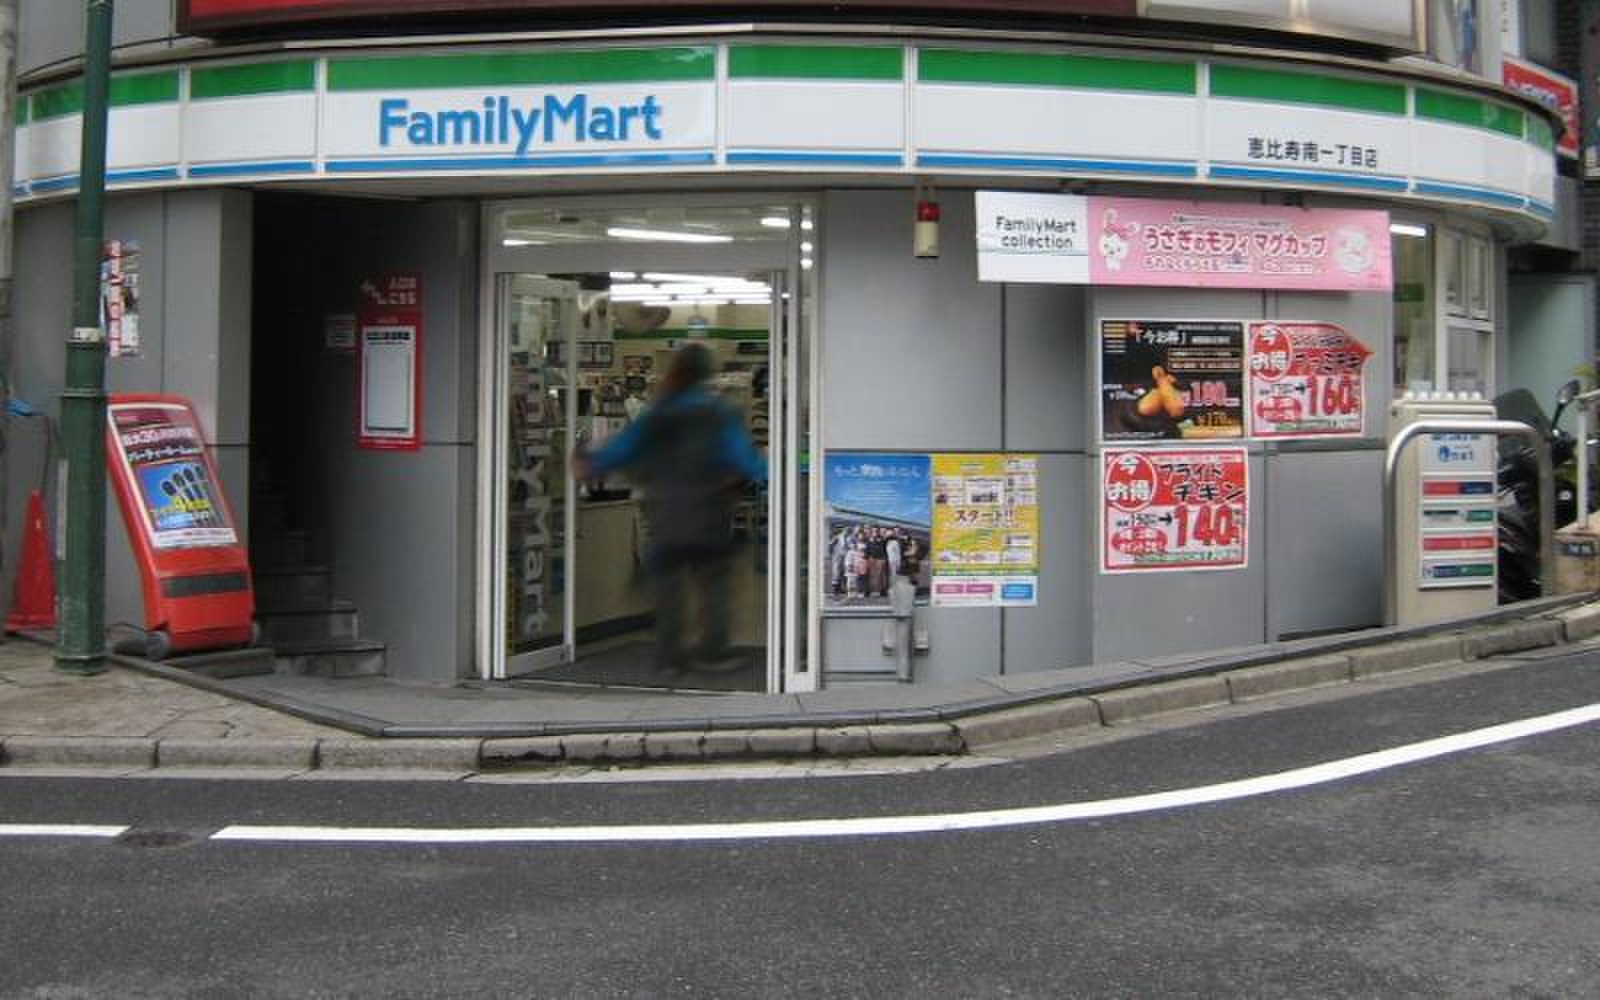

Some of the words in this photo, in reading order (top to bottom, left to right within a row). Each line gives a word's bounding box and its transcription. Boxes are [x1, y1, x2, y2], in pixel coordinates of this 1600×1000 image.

[379, 94, 662, 160] FamilyMart
[1248, 137, 1377, 168] 恵比寿南一丁目店
[995, 215, 1077, 234] FamilyMart
[1001, 234, 1073, 249] collection
